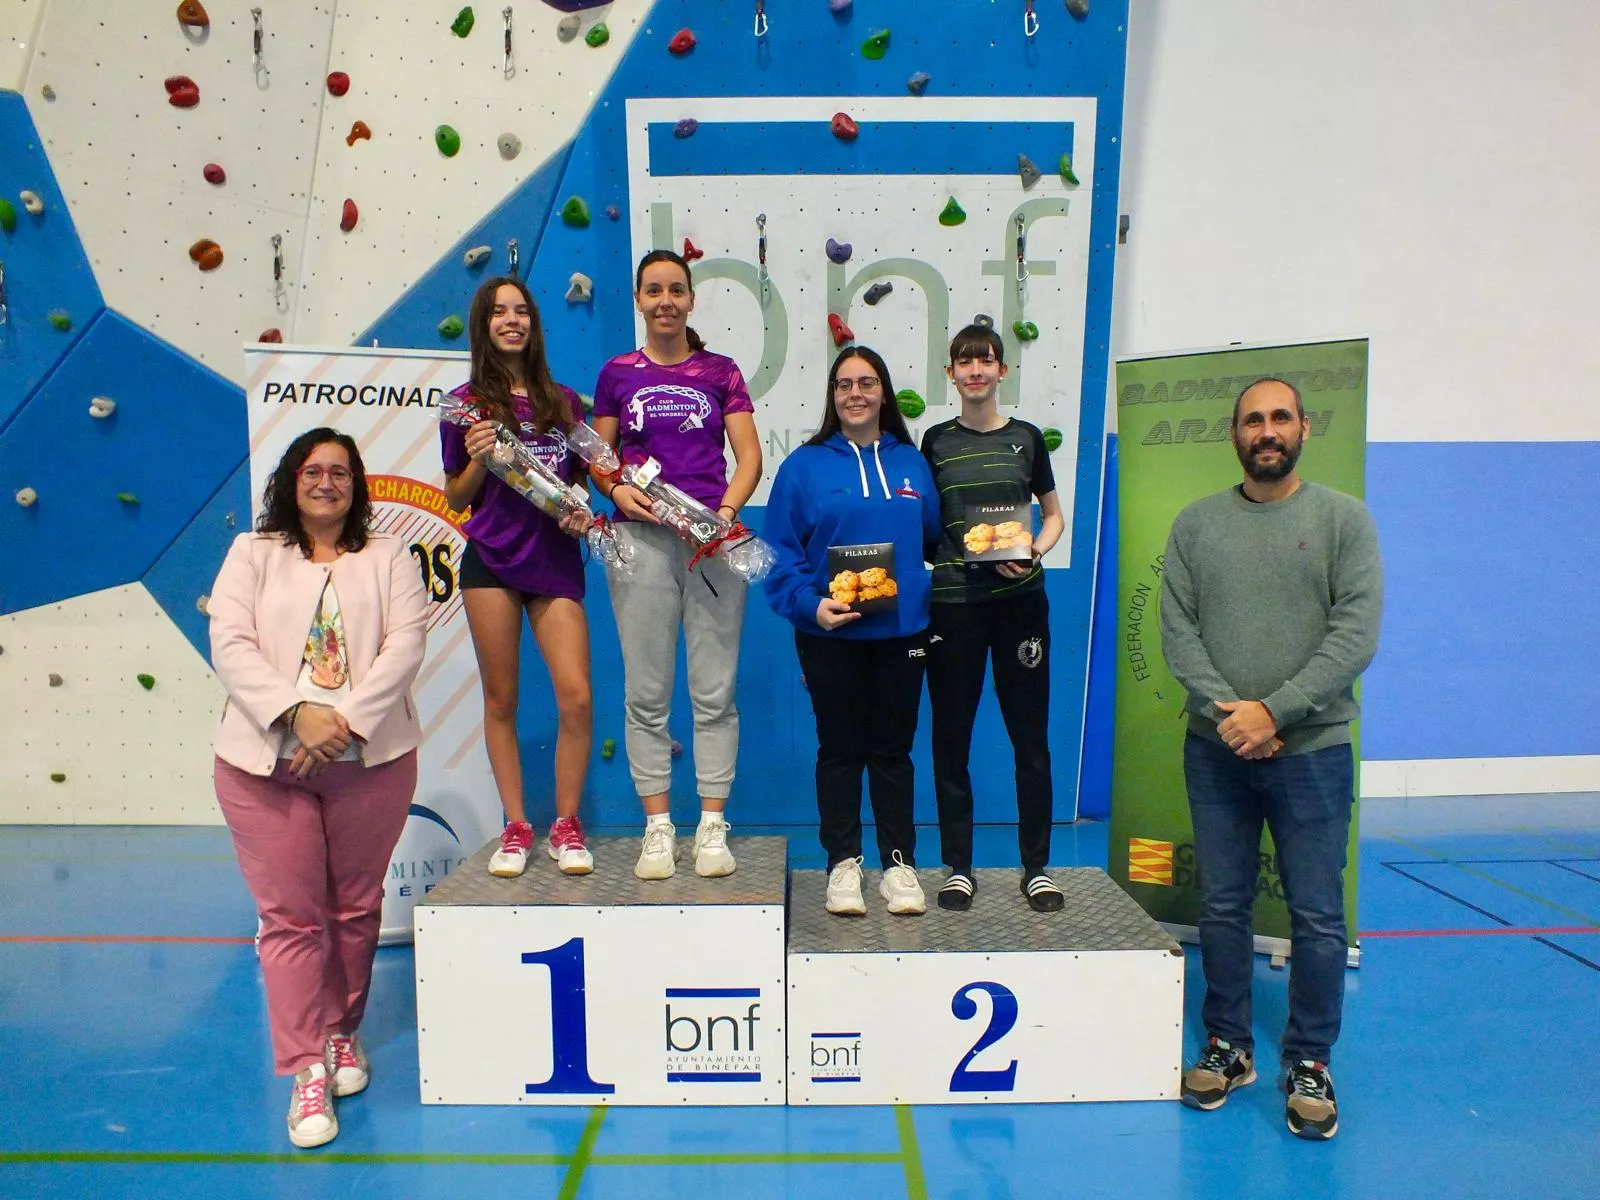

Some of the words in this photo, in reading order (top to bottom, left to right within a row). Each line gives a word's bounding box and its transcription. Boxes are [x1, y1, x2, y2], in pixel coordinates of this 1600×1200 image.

[651, 197, 1071, 406] bnf
[646, 404, 697, 412] BADMINTON
[1118, 366, 1364, 407] BADMITON
[1126, 582, 1152, 683] FEDERACION
[521, 937, 616, 1094] 1
[665, 1003, 761, 1052] bnf
[948, 981, 1019, 1092] 2
[811, 1041, 861, 1067] bnf
